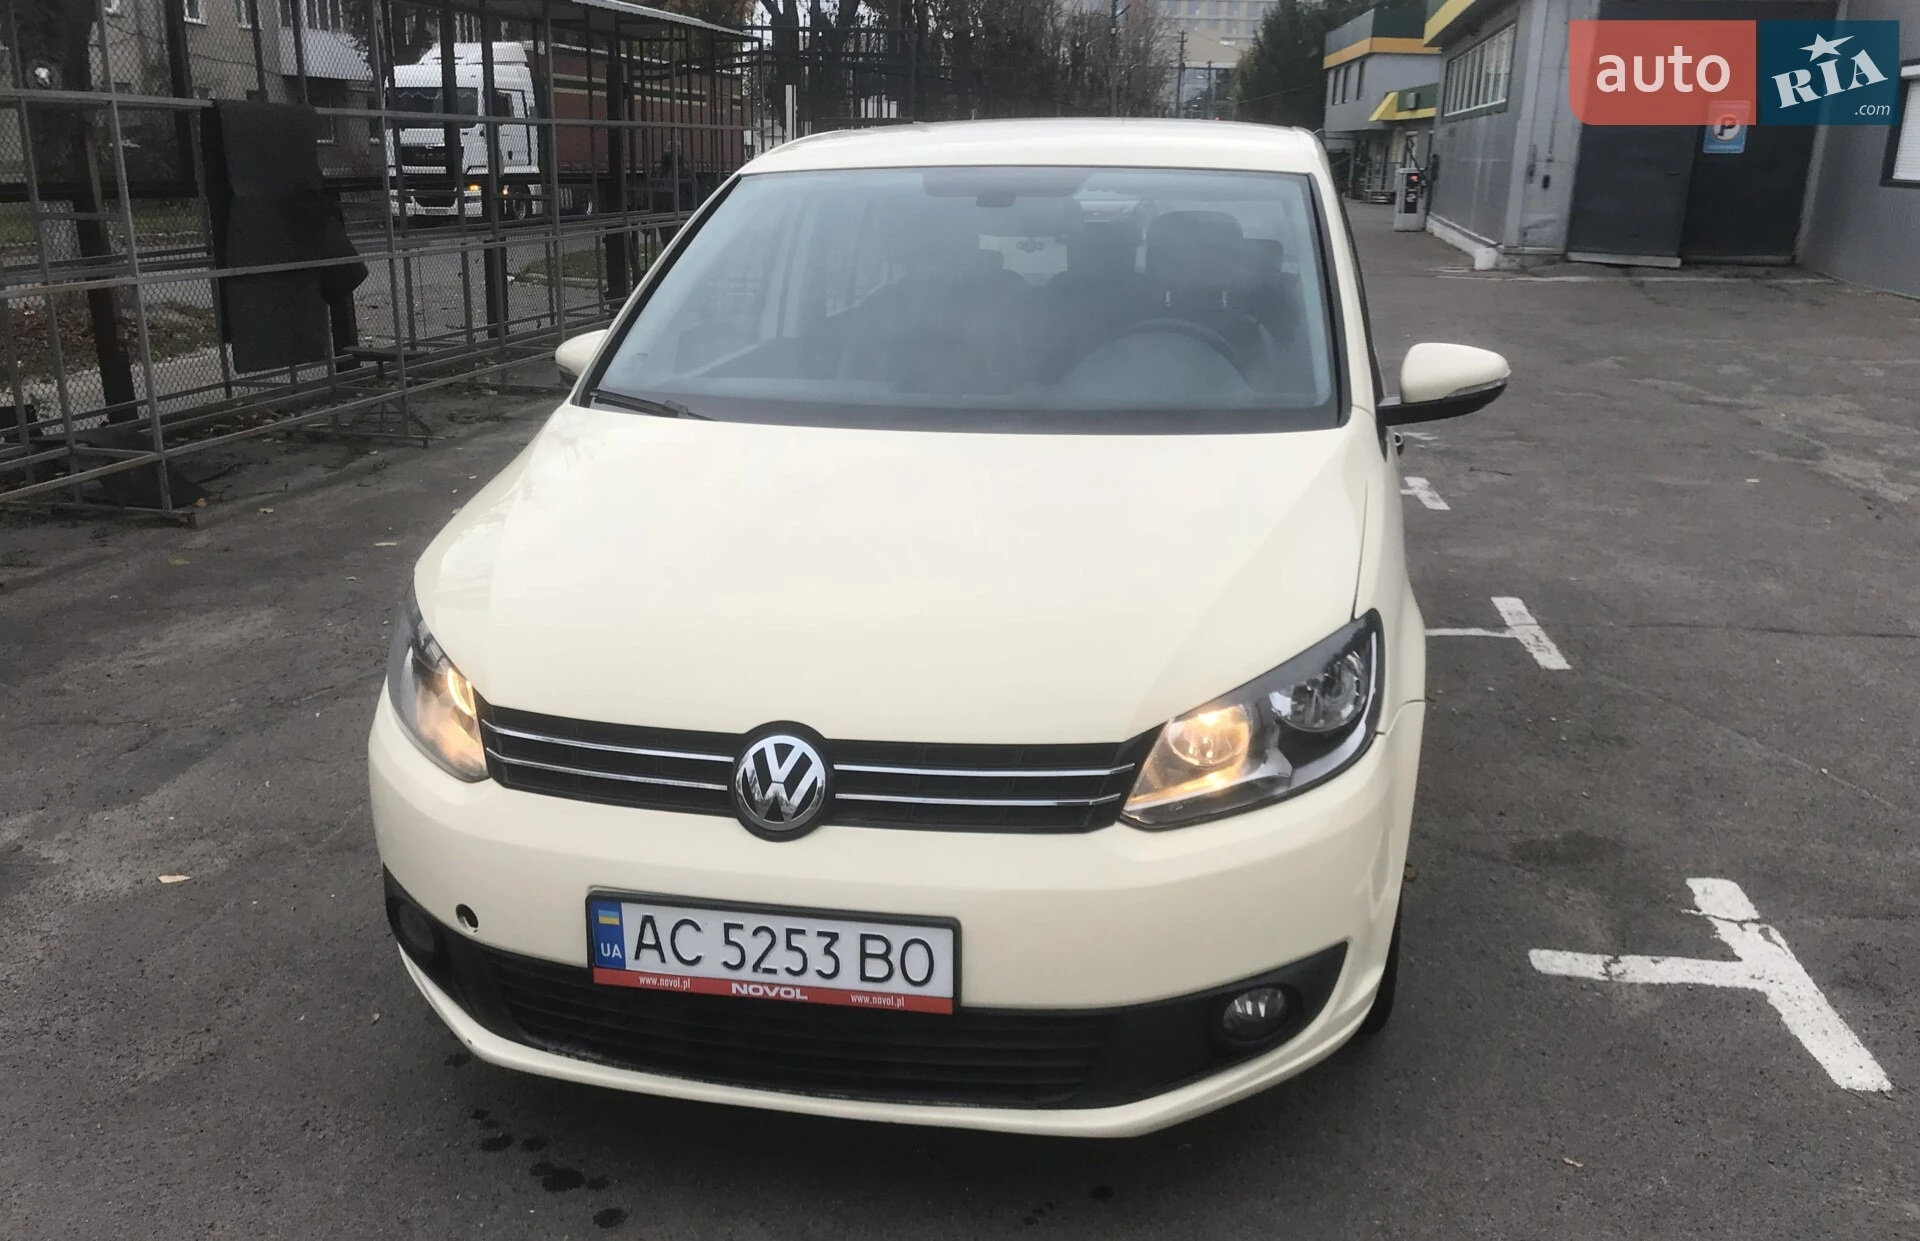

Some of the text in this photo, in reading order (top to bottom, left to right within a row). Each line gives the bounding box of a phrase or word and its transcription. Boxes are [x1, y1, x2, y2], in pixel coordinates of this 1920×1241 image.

[1717, 117, 1737, 137] P
[738, 737, 824, 829] VW
[601, 942, 623, 960] UA
[634, 914, 935, 987] AC 5253 BO
[638, 975, 905, 1009] www.novol.pl NOVOL www.novol.pl
